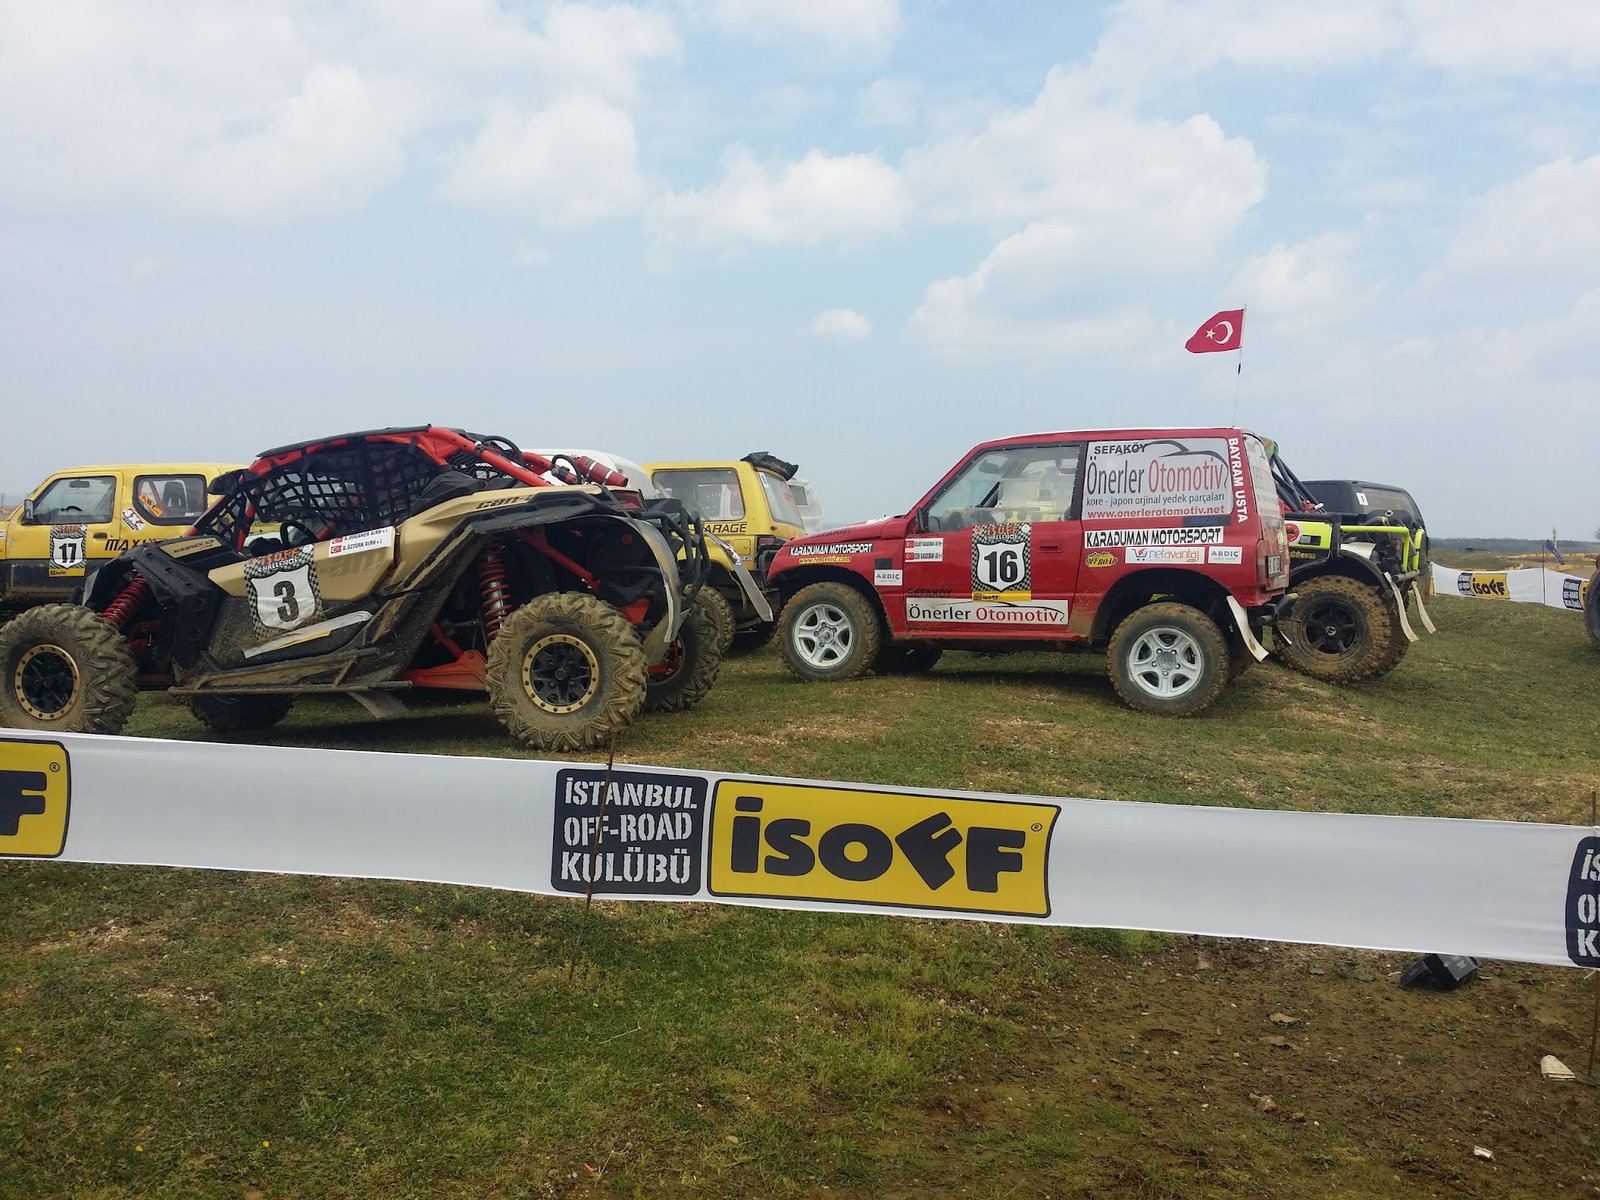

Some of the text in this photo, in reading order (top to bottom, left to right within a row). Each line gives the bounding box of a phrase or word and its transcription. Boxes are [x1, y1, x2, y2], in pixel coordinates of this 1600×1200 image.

[1094, 443, 1147, 455] SEFAKÖY
[1087, 456, 1223, 495] Önerler Otomotiv
[1229, 438, 1248, 523] BAYRAM USTA
[1087, 497, 1103, 507] kore
[1110, 496, 1133, 508] japon
[1135, 494, 1161, 506] orjinal
[1162, 493, 1187, 505] yedek
[1188, 492, 1225, 504] parçaları
[1088, 505, 1225, 519] www.onerlerotomotiv.net
[690, 524, 748, 533] ARAGE
[1086, 528, 1221, 547] KARADUMAN MOTORSPORT
[59, 543, 77, 563] 17
[790, 543, 873, 556] KARADUMAN MOTORSPORT
[984, 550, 1018, 583] 16
[274, 580, 300, 623] 3
[909, 603, 1058, 623] Önerler Otomotiv
[563, 812, 692, 844] OFF-ROAD
[561, 847, 692, 884] KULÜBÜ
